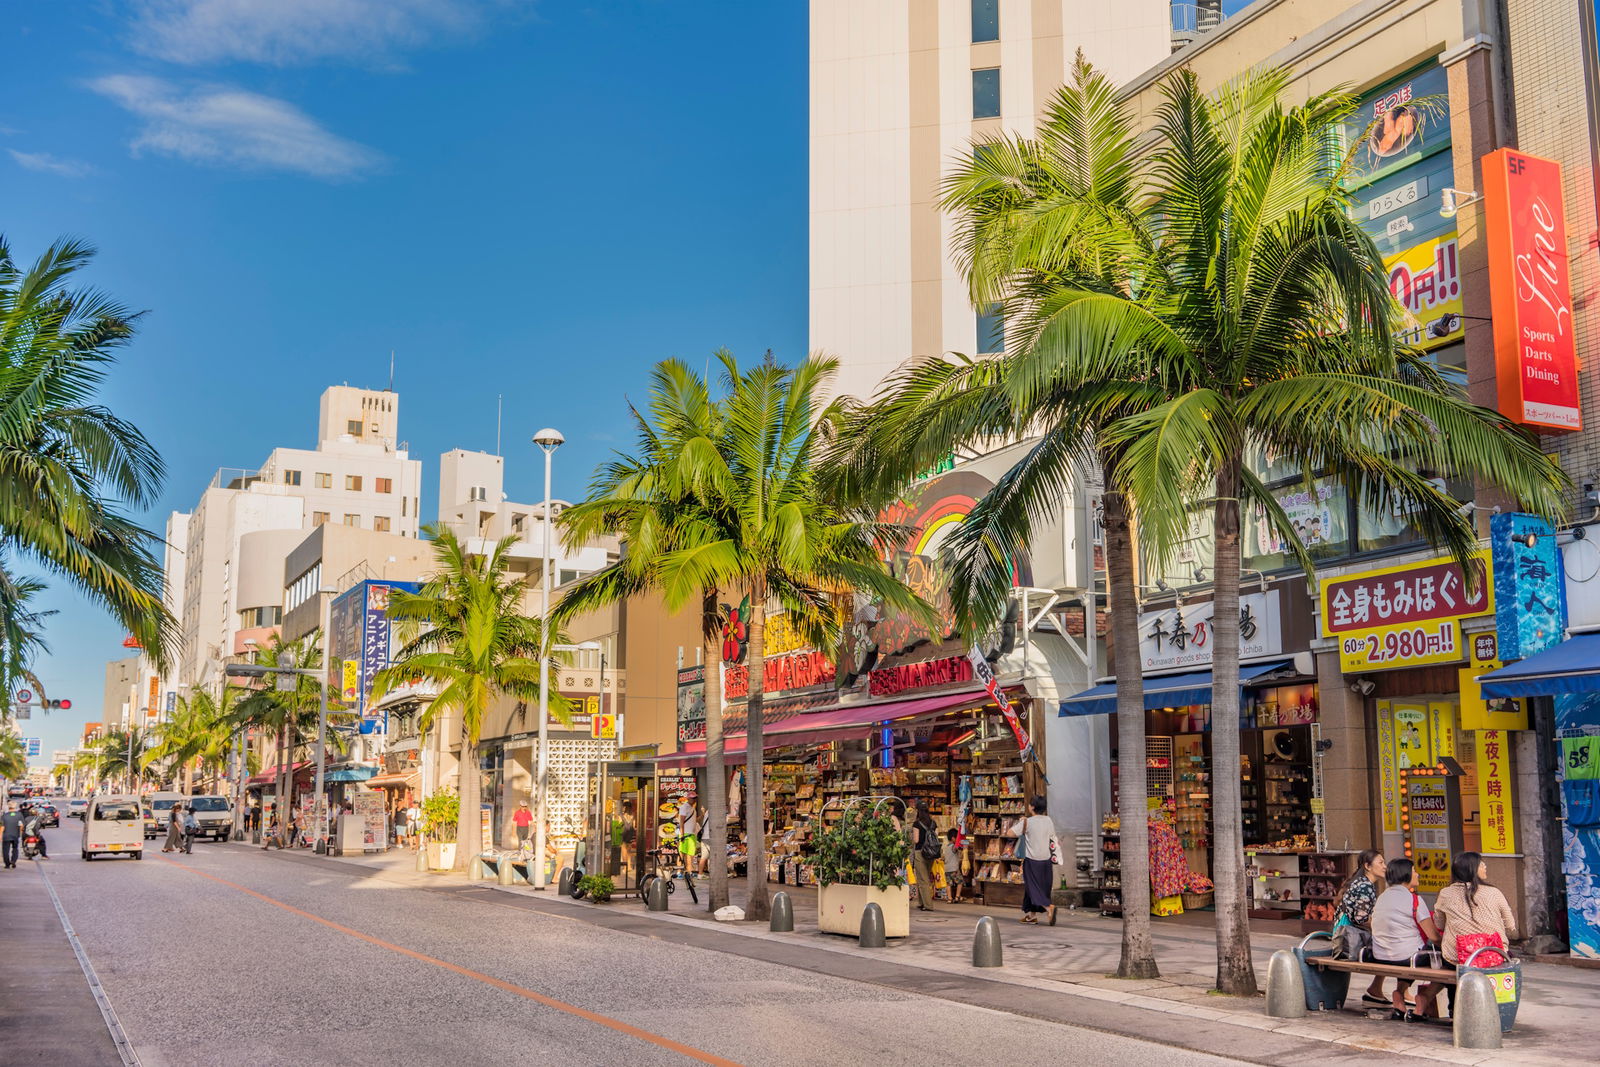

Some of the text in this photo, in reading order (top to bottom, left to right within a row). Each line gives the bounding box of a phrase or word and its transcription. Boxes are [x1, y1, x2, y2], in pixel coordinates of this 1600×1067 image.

[1373, 82, 1412, 118] 足つぼ
[1508, 156, 1526, 175] SF
[1373, 187, 1416, 216] りらくる
[1523, 326, 1556, 343] Sports
[1525, 346, 1553, 361] Darts
[1526, 366, 1560, 385] Dining
[366, 614, 378, 676] アニメグッズ
[376, 620, 388, 671] フィギュア
[1343, 622, 1454, 661] 60分 2,980円!!
[1147, 657, 1176, 667] Okinawan
[1176, 654, 1196, 666] goods
[1196, 652, 1211, 662] shop
[1243, 645, 1263, 654] Ichiba
[595, 716, 609, 737] P
[1568, 746, 1590, 769] 58
